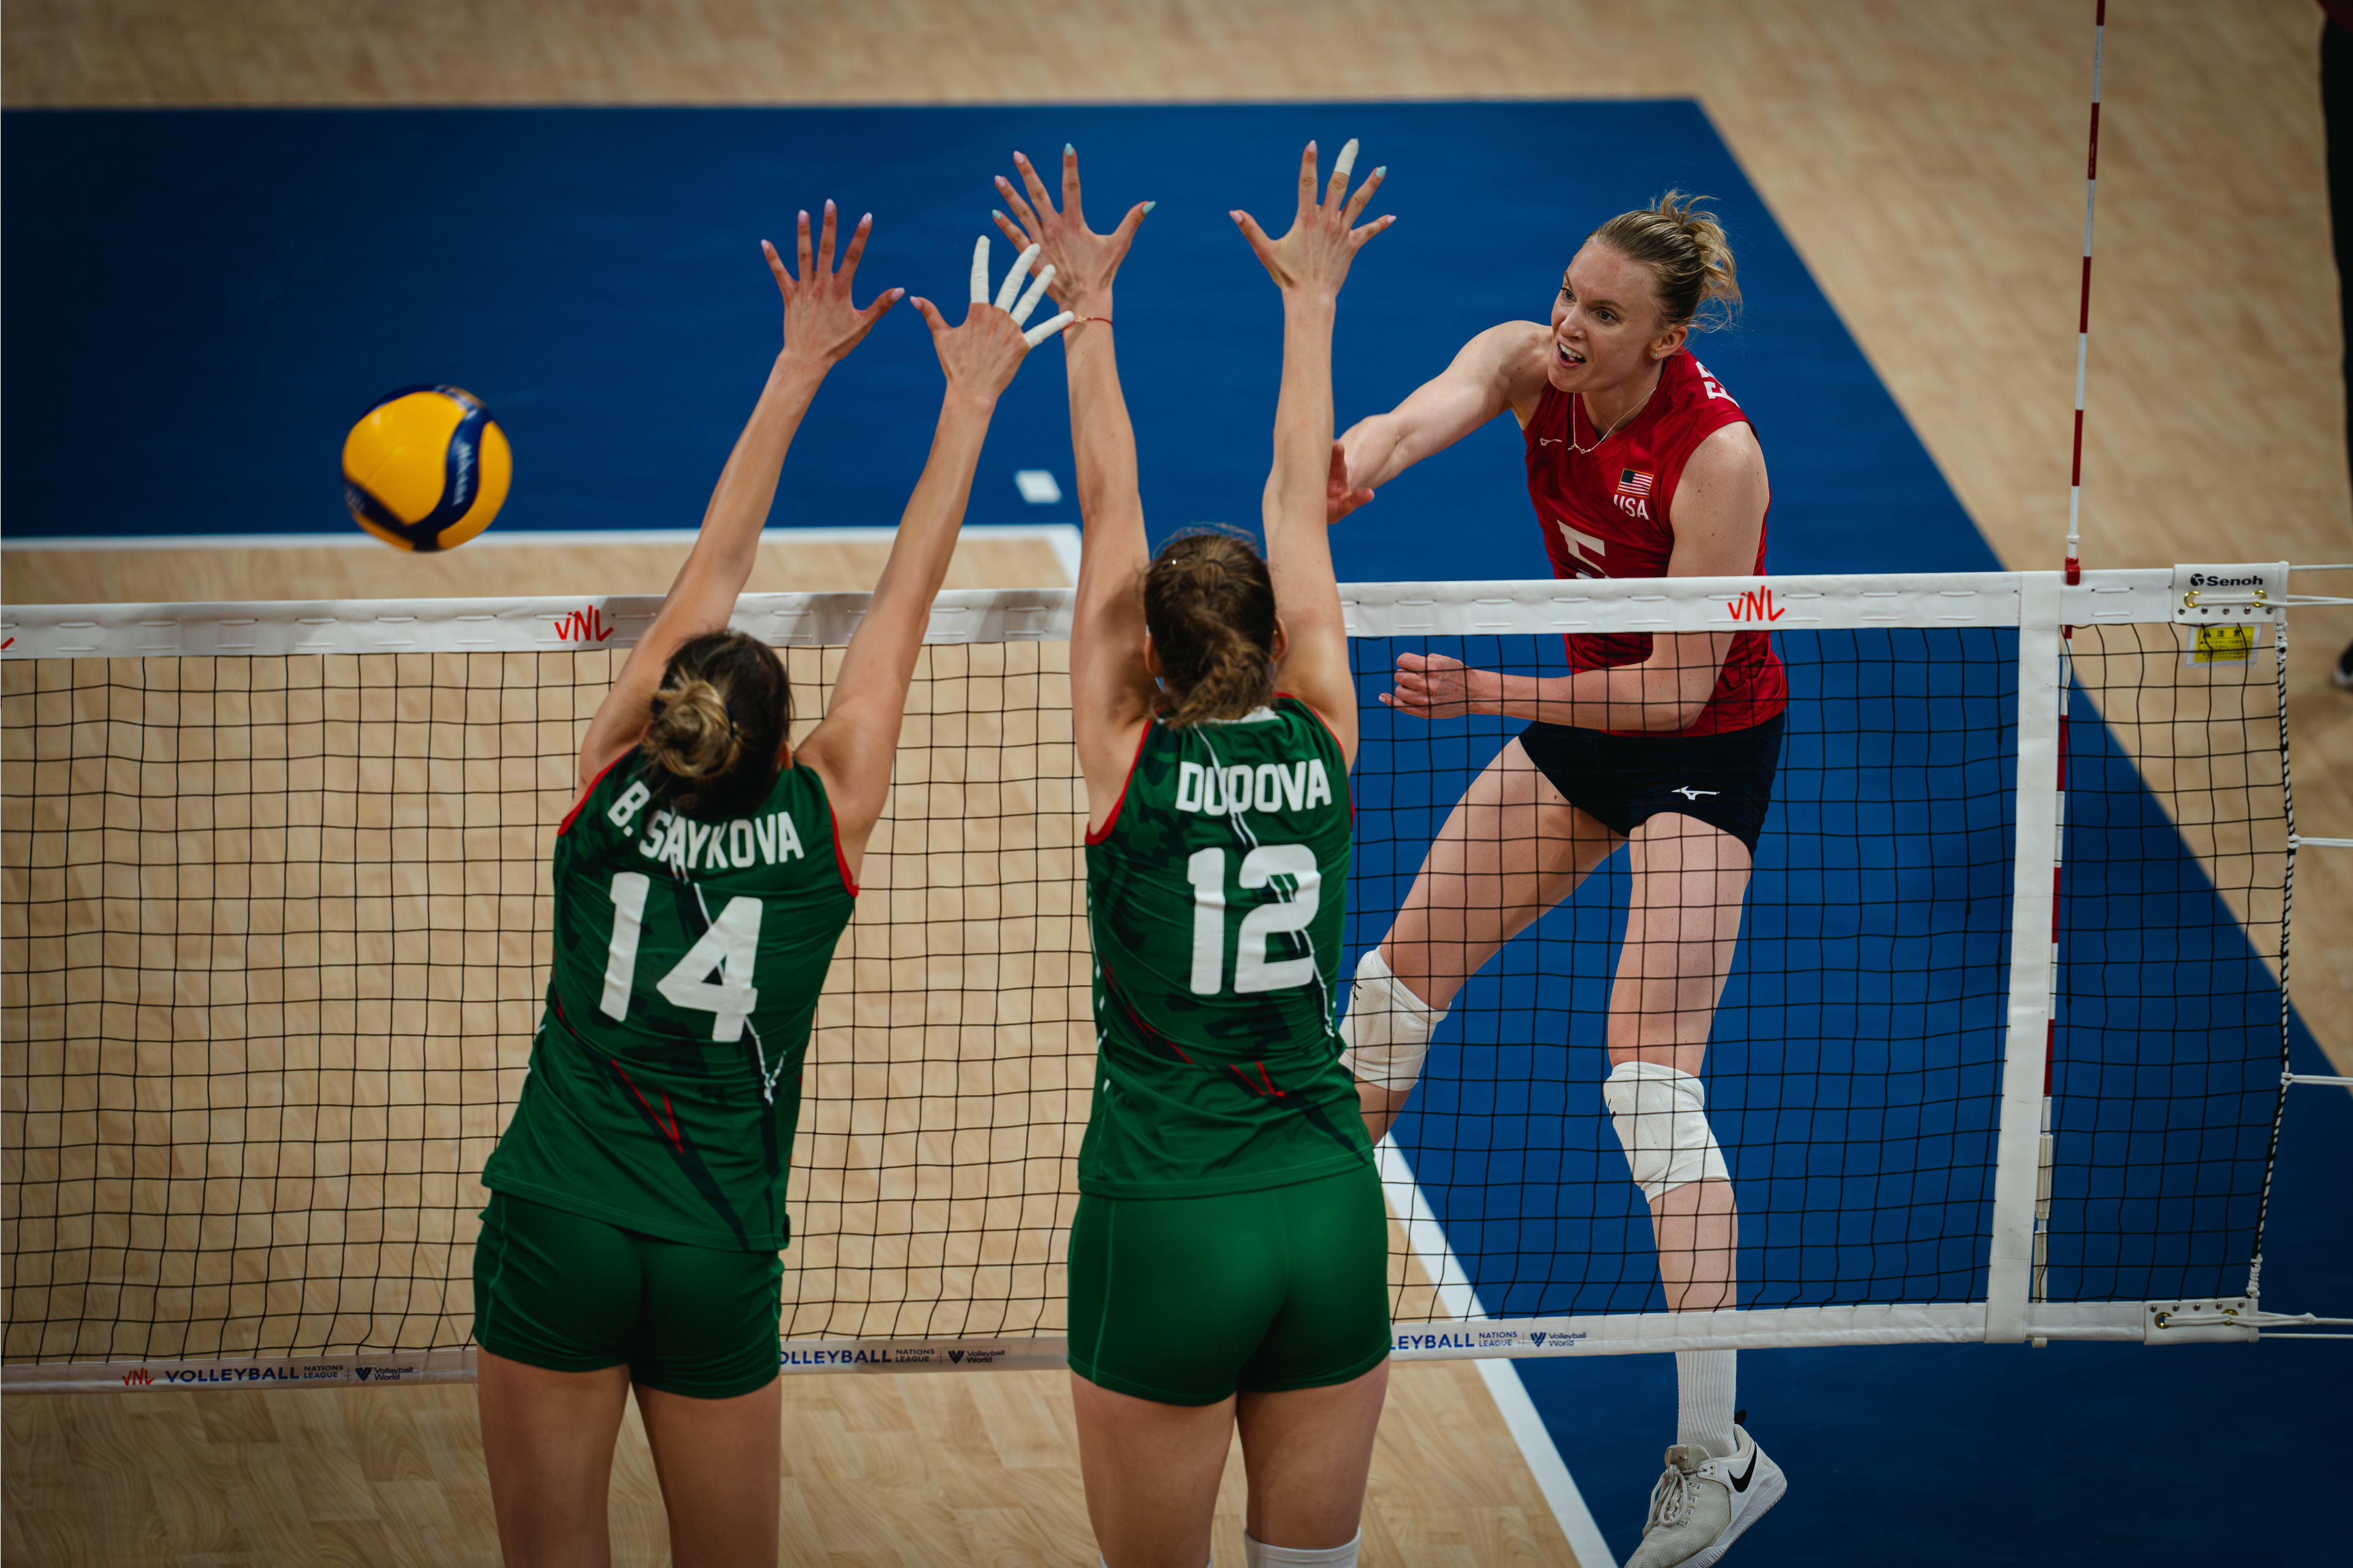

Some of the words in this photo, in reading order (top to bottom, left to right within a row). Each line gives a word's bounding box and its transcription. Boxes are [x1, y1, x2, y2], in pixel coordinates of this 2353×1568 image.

[2207, 575, 2263, 587] Senoh
[1175, 758, 1333, 816] DUDOVA
[607, 779, 651, 837] B.
[638, 811, 805, 869] SAYKOVA
[1187, 843, 1322, 995] 12
[599, 871, 763, 1042] 14
[780, 1349, 892, 1365] OLLEYBALL
[1390, 1333, 1475, 1350] EYBALL
[165, 1366, 300, 1383] VOLLEYBALL
